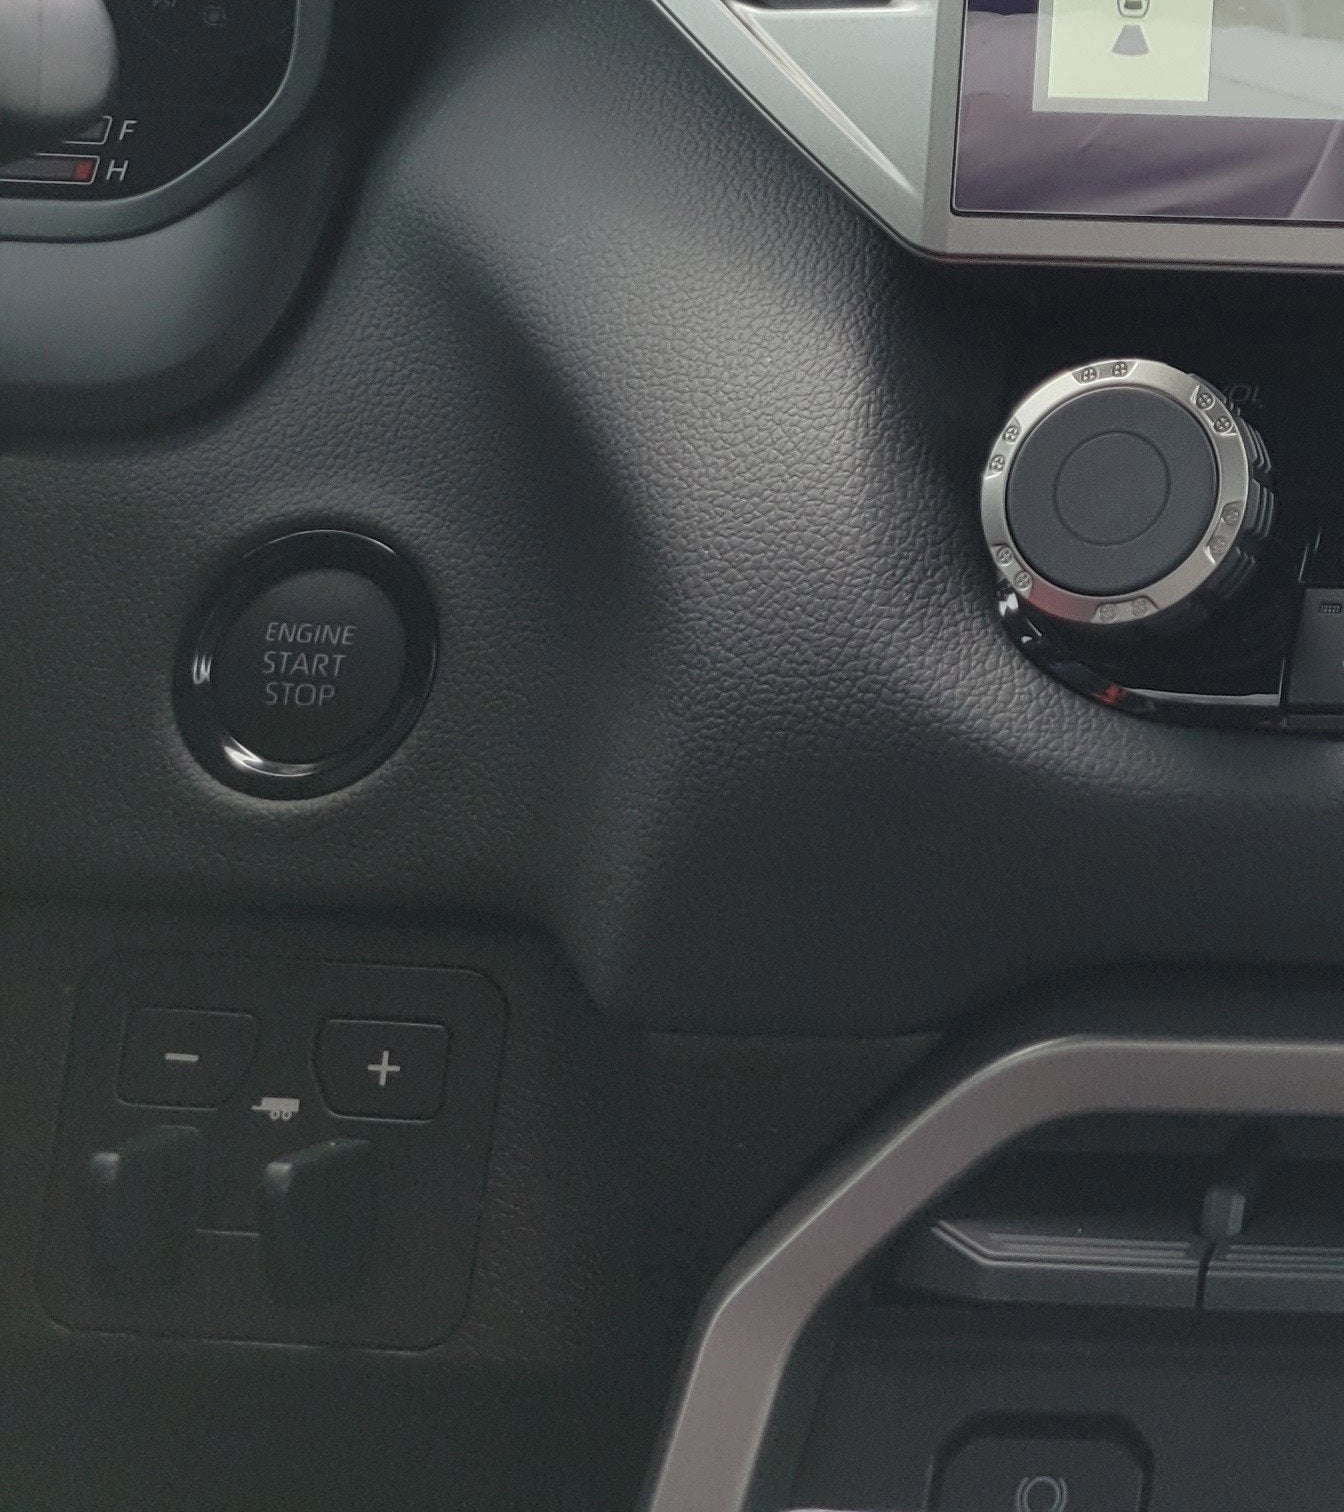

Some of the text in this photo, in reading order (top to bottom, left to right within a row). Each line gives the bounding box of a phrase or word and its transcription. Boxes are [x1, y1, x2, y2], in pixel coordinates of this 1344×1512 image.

[118, 119, 138, 142] F
[105, 159, 130, 182] H
[265, 621, 357, 646] ENGINE
[262, 651, 347, 677] START
[263, 682, 336, 707] STOP
